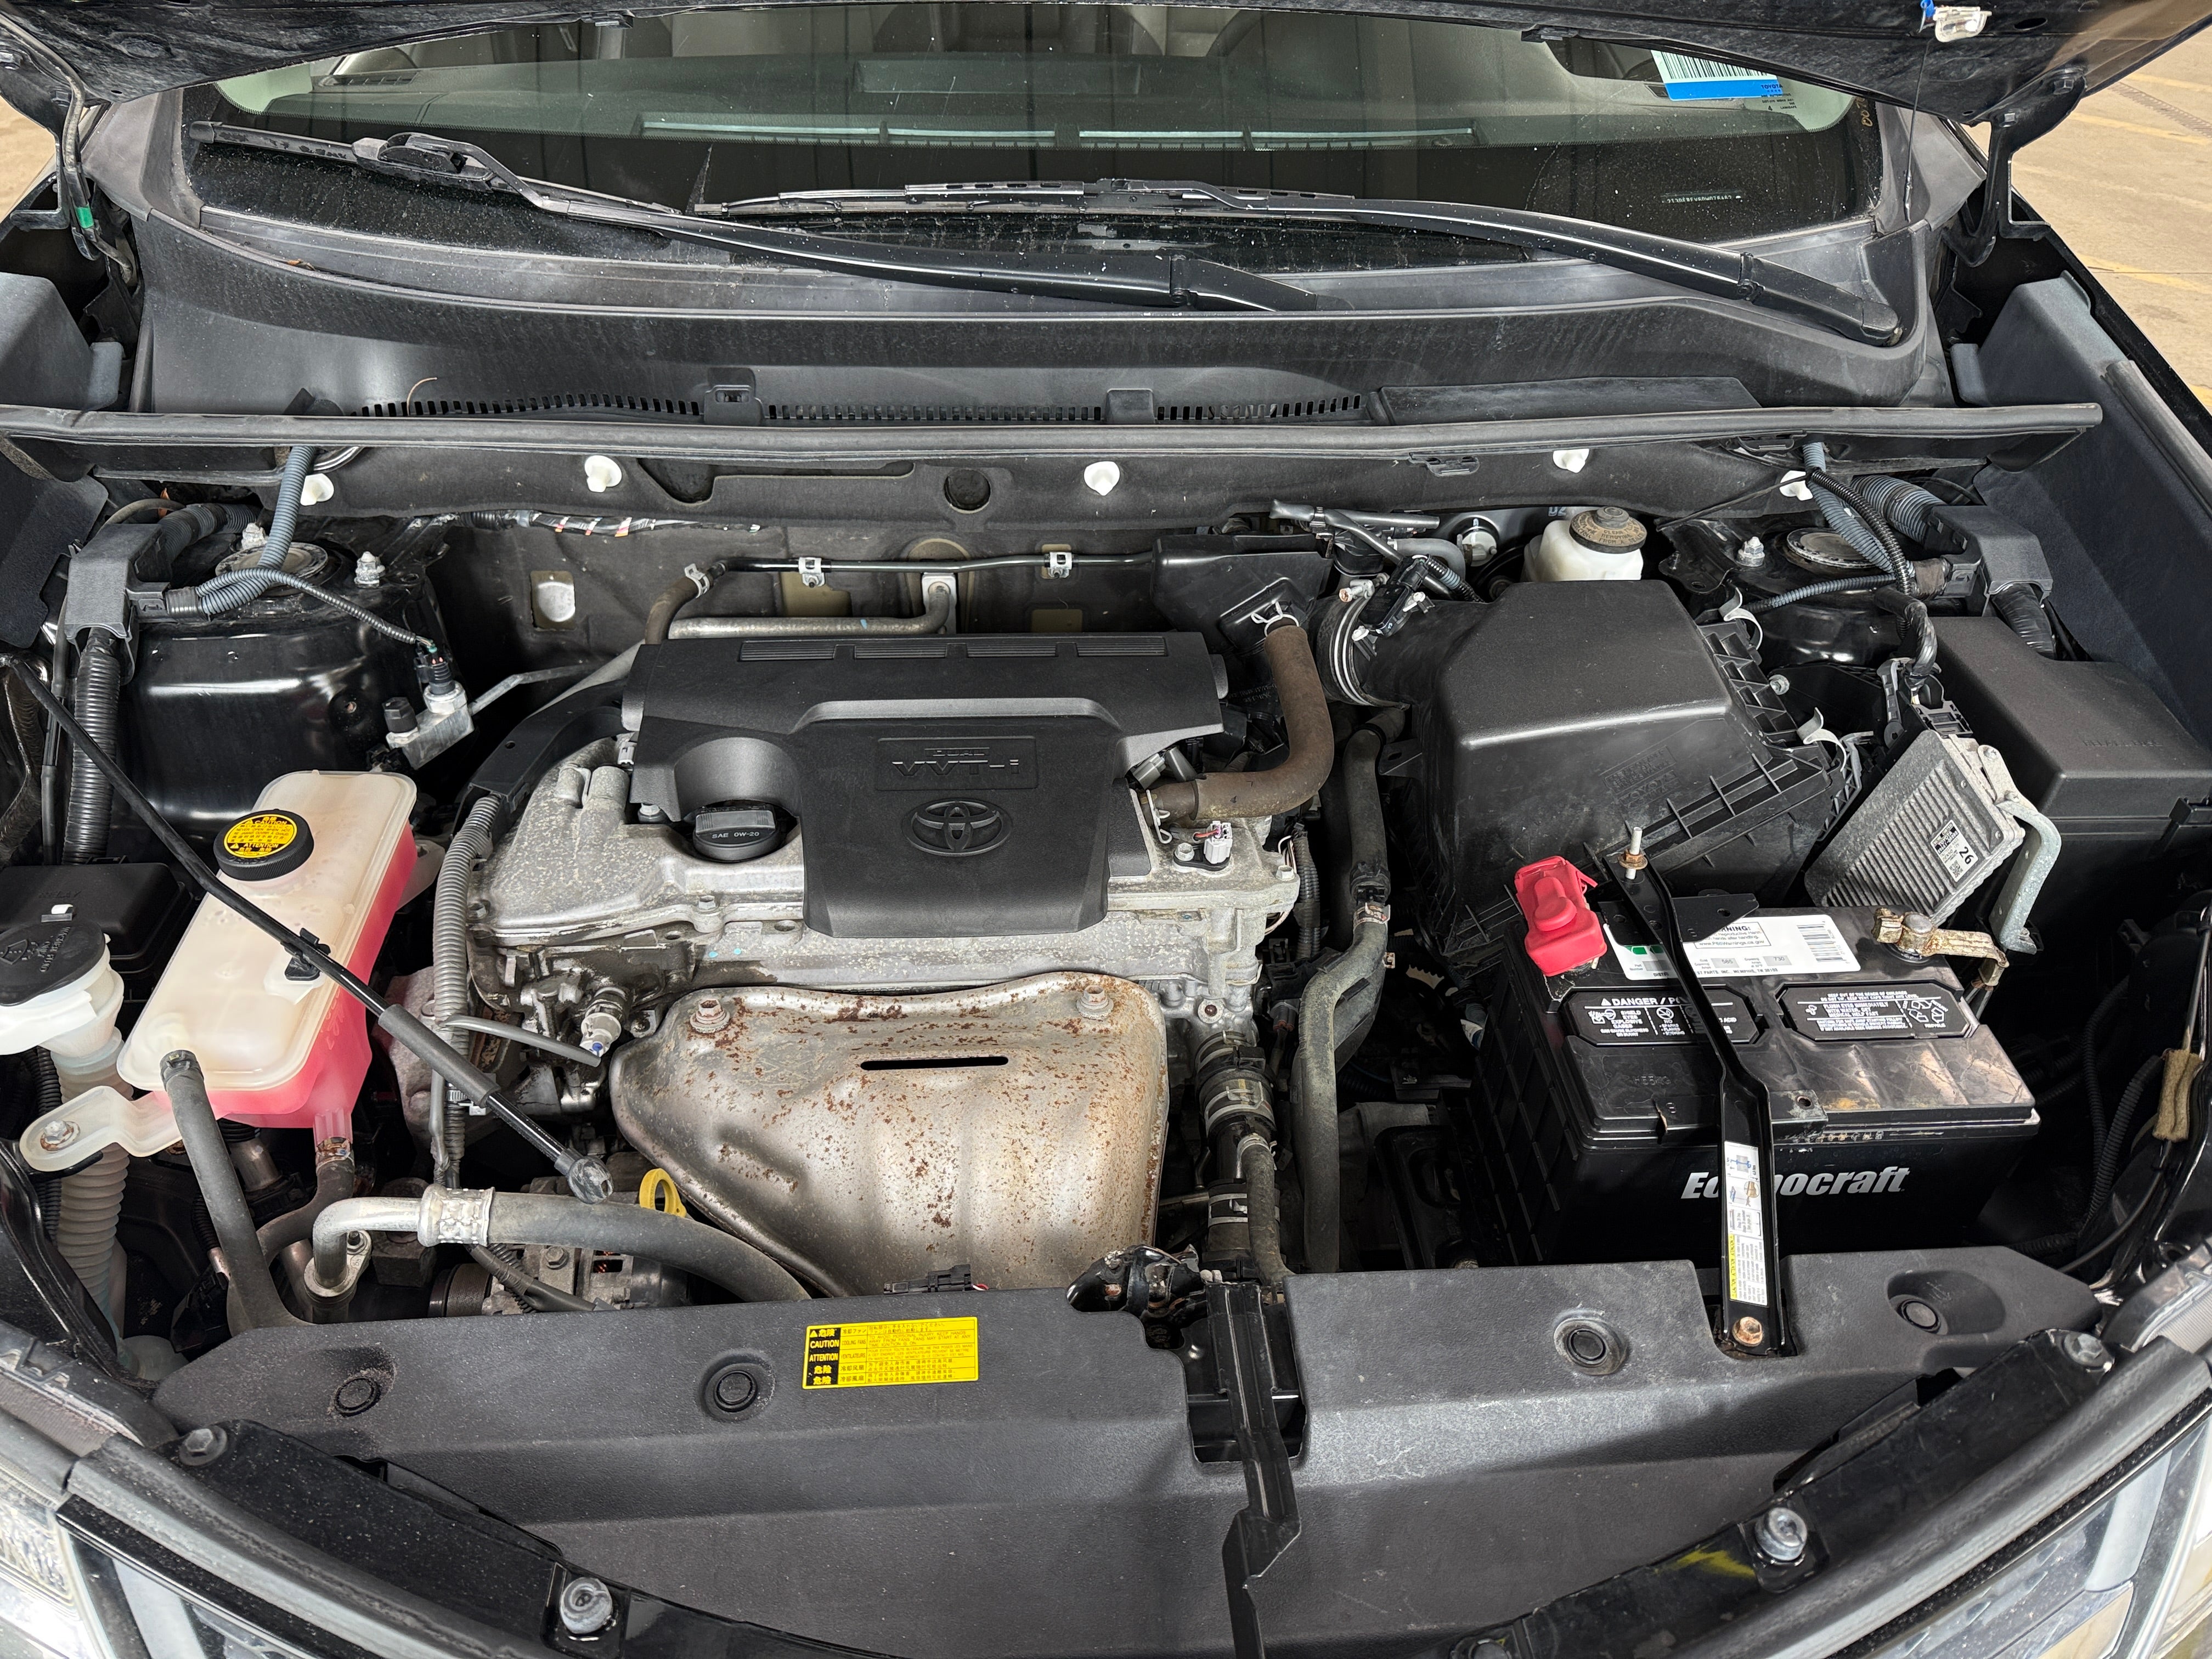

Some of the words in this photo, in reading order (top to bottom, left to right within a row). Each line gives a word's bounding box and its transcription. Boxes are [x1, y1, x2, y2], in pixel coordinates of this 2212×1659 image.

[1959, 847, 1974, 865] 26
[810, 1339, 839, 1348] CAUTION
[809, 1353, 838, 1362] ATTENTION
